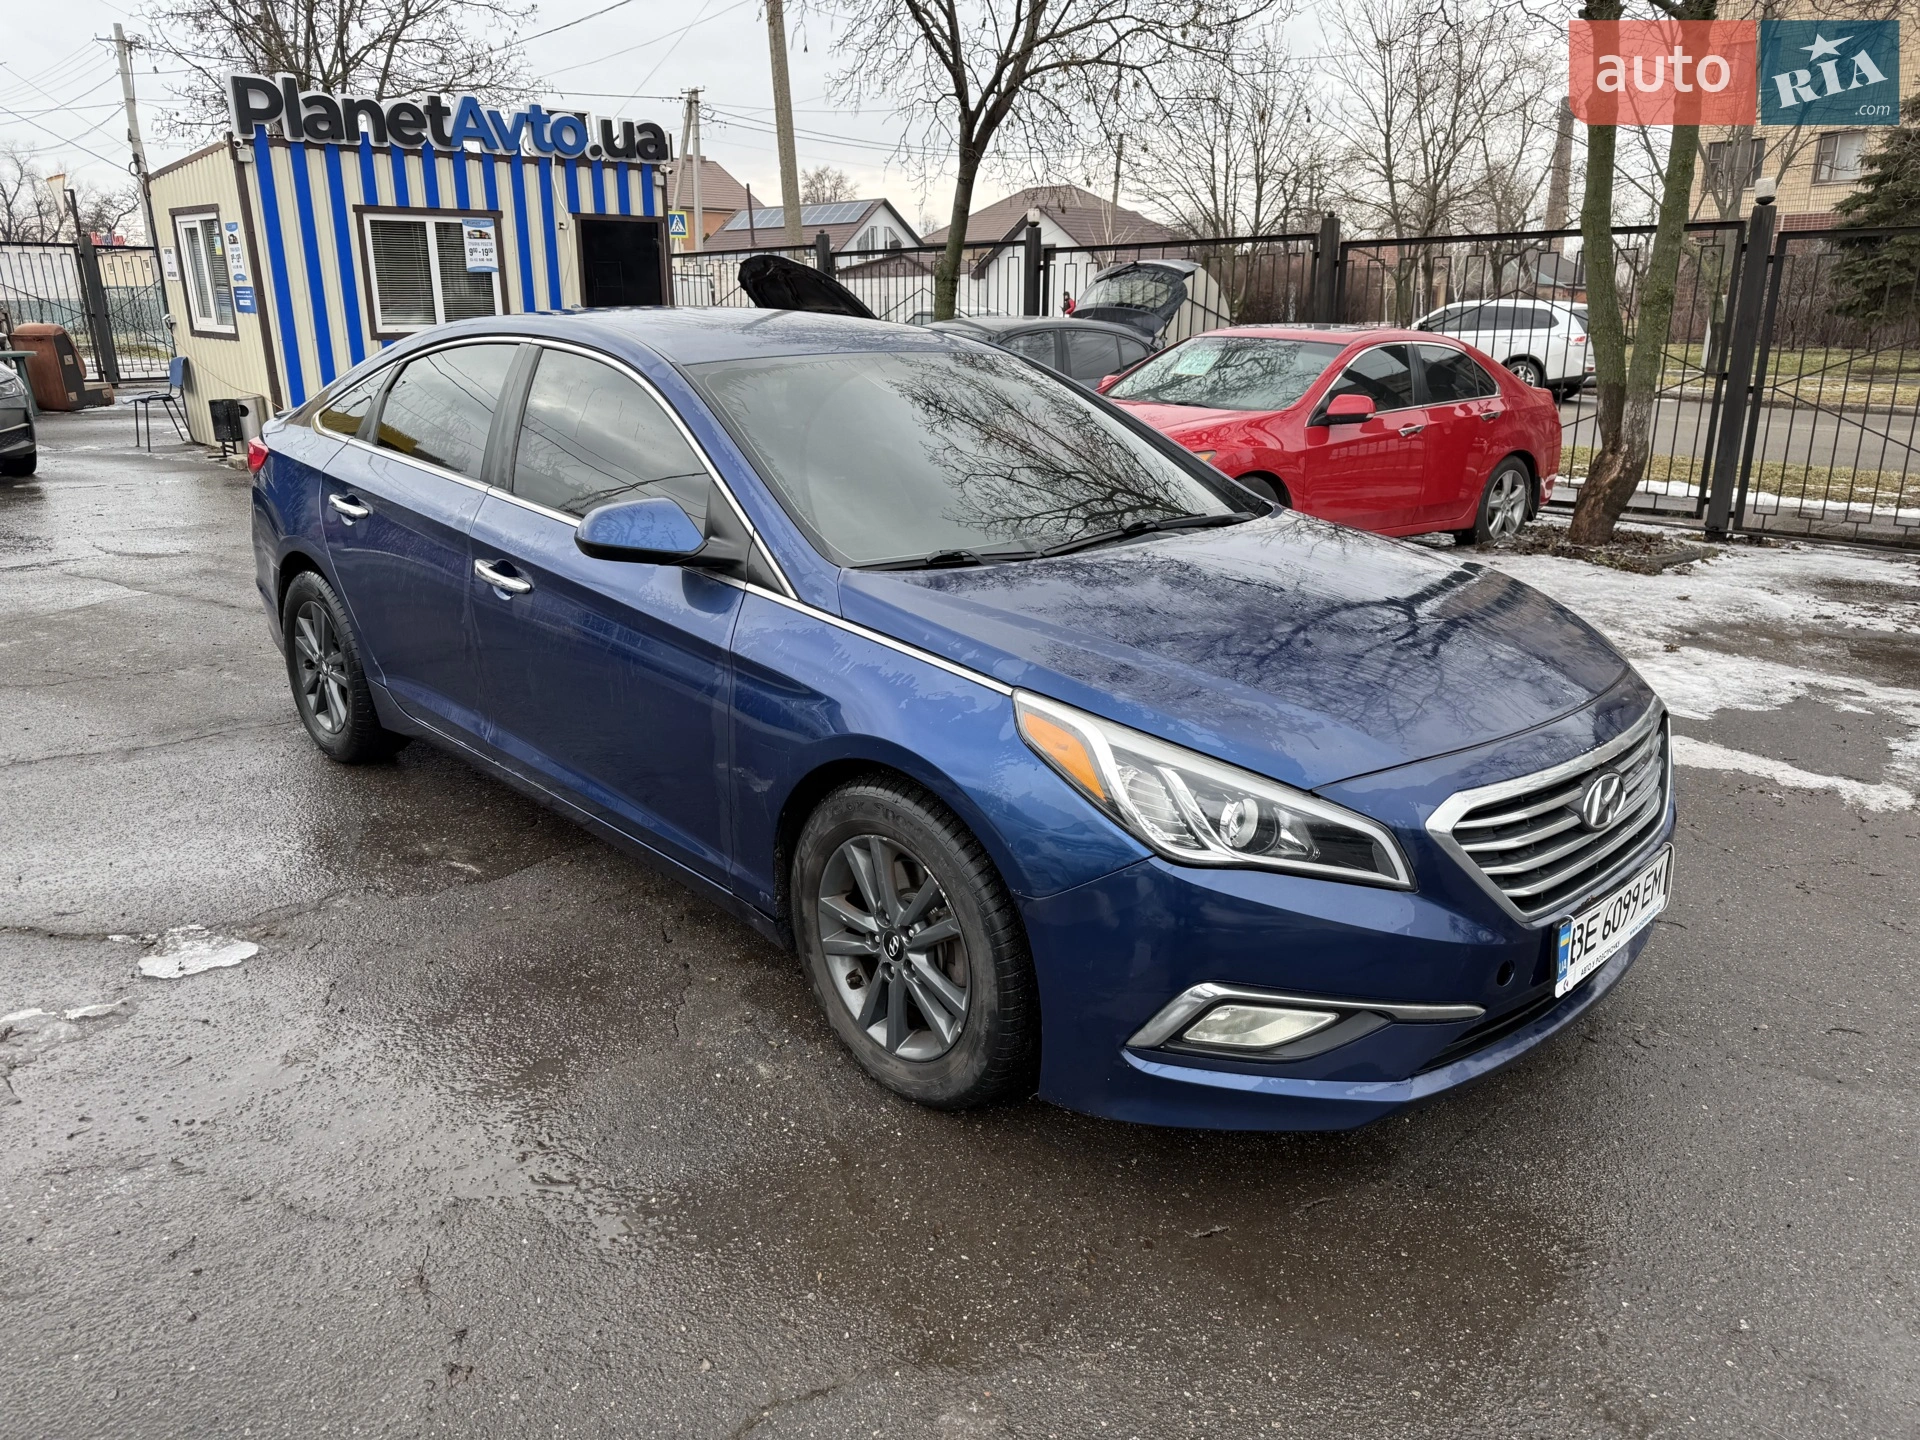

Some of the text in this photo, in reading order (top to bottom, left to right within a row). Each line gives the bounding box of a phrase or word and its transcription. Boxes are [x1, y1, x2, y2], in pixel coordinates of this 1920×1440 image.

[227, 72, 671, 162] PlanetAvto.ua
[1602, 882, 1641, 941] 6099
[1558, 958, 1567, 974] UA
